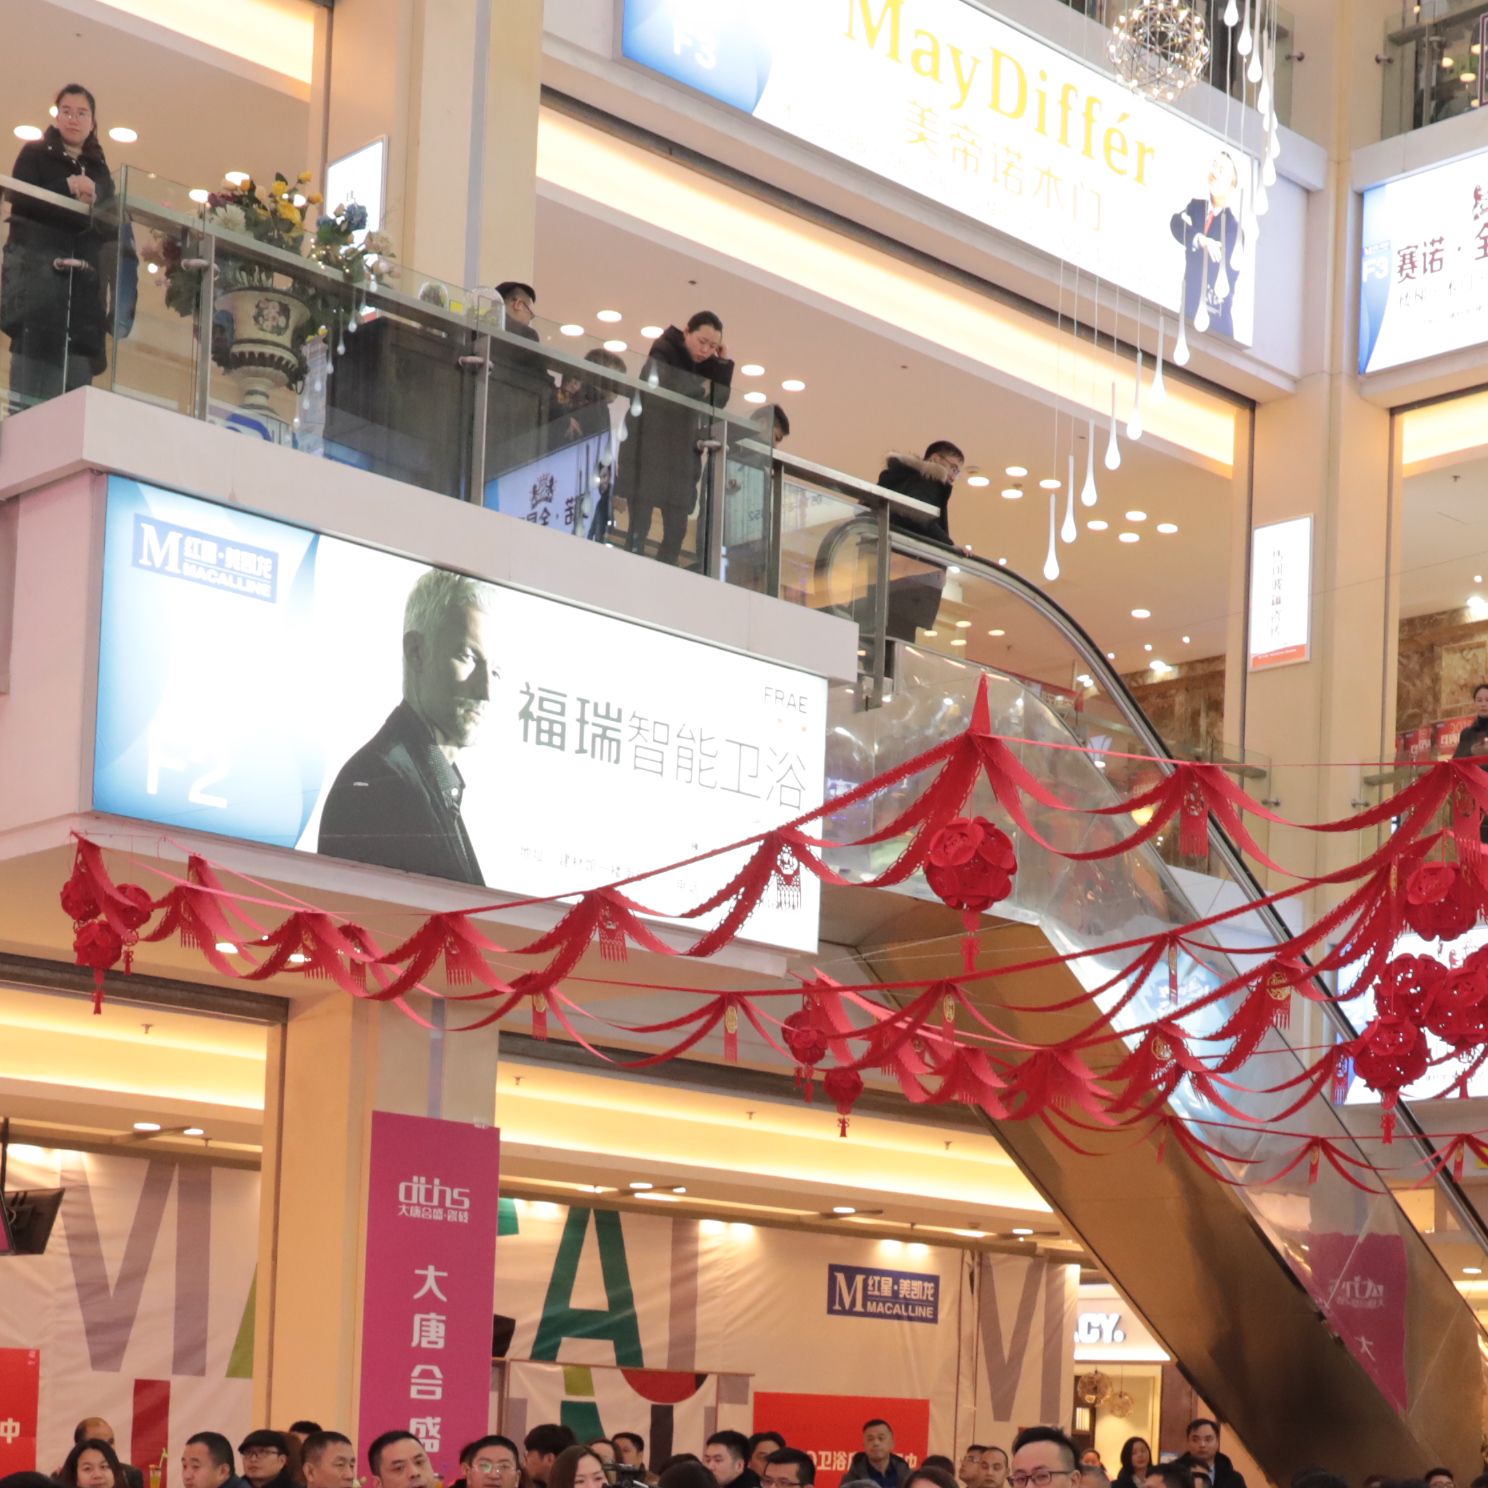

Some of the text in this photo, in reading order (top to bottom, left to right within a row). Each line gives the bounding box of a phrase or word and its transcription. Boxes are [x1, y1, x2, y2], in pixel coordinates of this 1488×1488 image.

[1362, 256, 1390, 283] F3
[138, 522, 184, 575] M
[182, 561, 272, 599] MACALLINE
[763, 687, 808, 715] FRAE
[518, 681, 807, 811] 福瑞智能卫浴
[833, 1272, 866, 1313] M
[866, 1275, 935, 1301] 红星·美凯龙
[866, 1300, 935, 1319] MACALLINE
[1074, 1312, 1126, 1344] CY.
[409, 1264, 449, 1453] 大唐合盛
